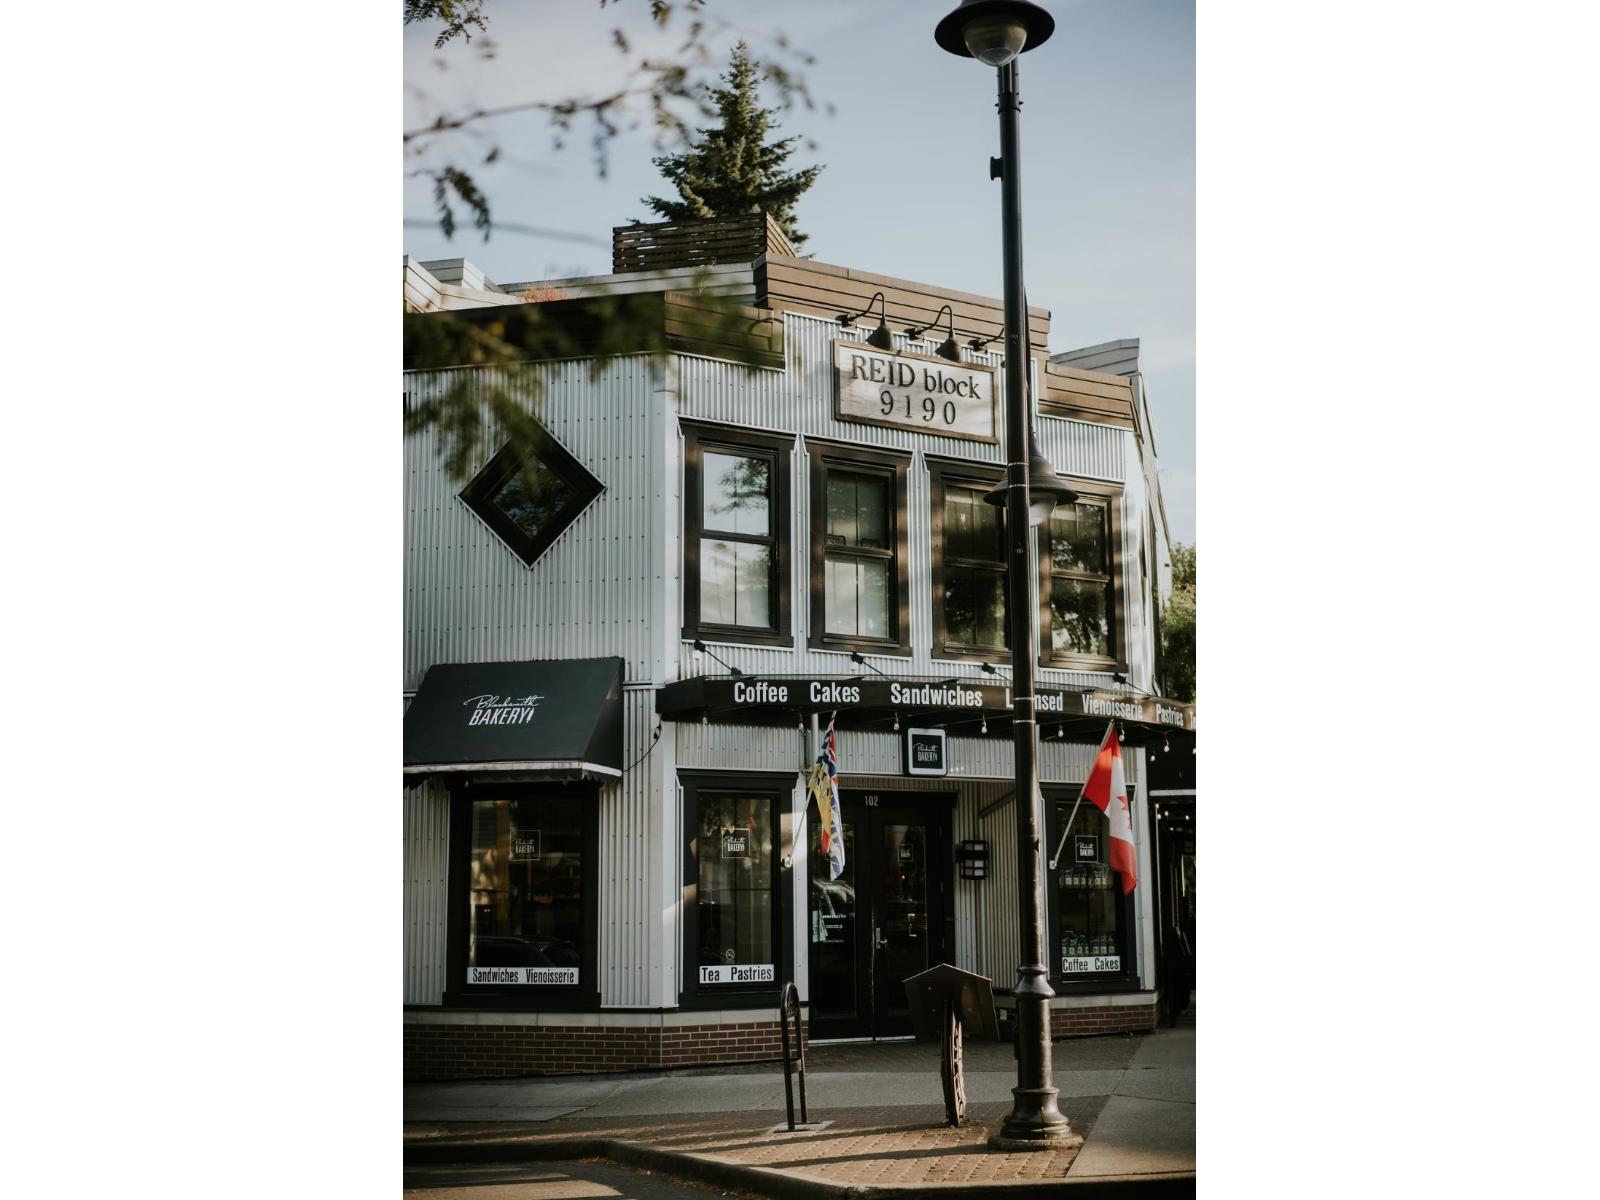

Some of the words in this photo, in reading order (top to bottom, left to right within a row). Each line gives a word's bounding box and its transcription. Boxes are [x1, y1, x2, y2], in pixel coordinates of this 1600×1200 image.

[851, 354, 915, 387] REID
[923, 368, 981, 400] block
[880, 390, 956, 425] 9190
[463, 694, 545, 709] Blacksmith
[734, 681, 788, 703] Coffee
[810, 681, 860, 703] Cakes
[890, 682, 983, 707] Sandwiches
[1005, 688, 1064, 712] Lnsed
[1082, 693, 1143, 720] Vienoisserie
[1155, 703, 1184, 726] Pastries
[864, 795, 879, 807] 102
[1062, 958, 1088, 972] Coffee
[1094, 957, 1119, 970] Cakes
[472, 968, 519, 983] Sandwiches
[525, 968, 574, 984] Vienoisserie
[701, 967, 720, 981] Tea
[731, 965, 772, 981] Pastries
